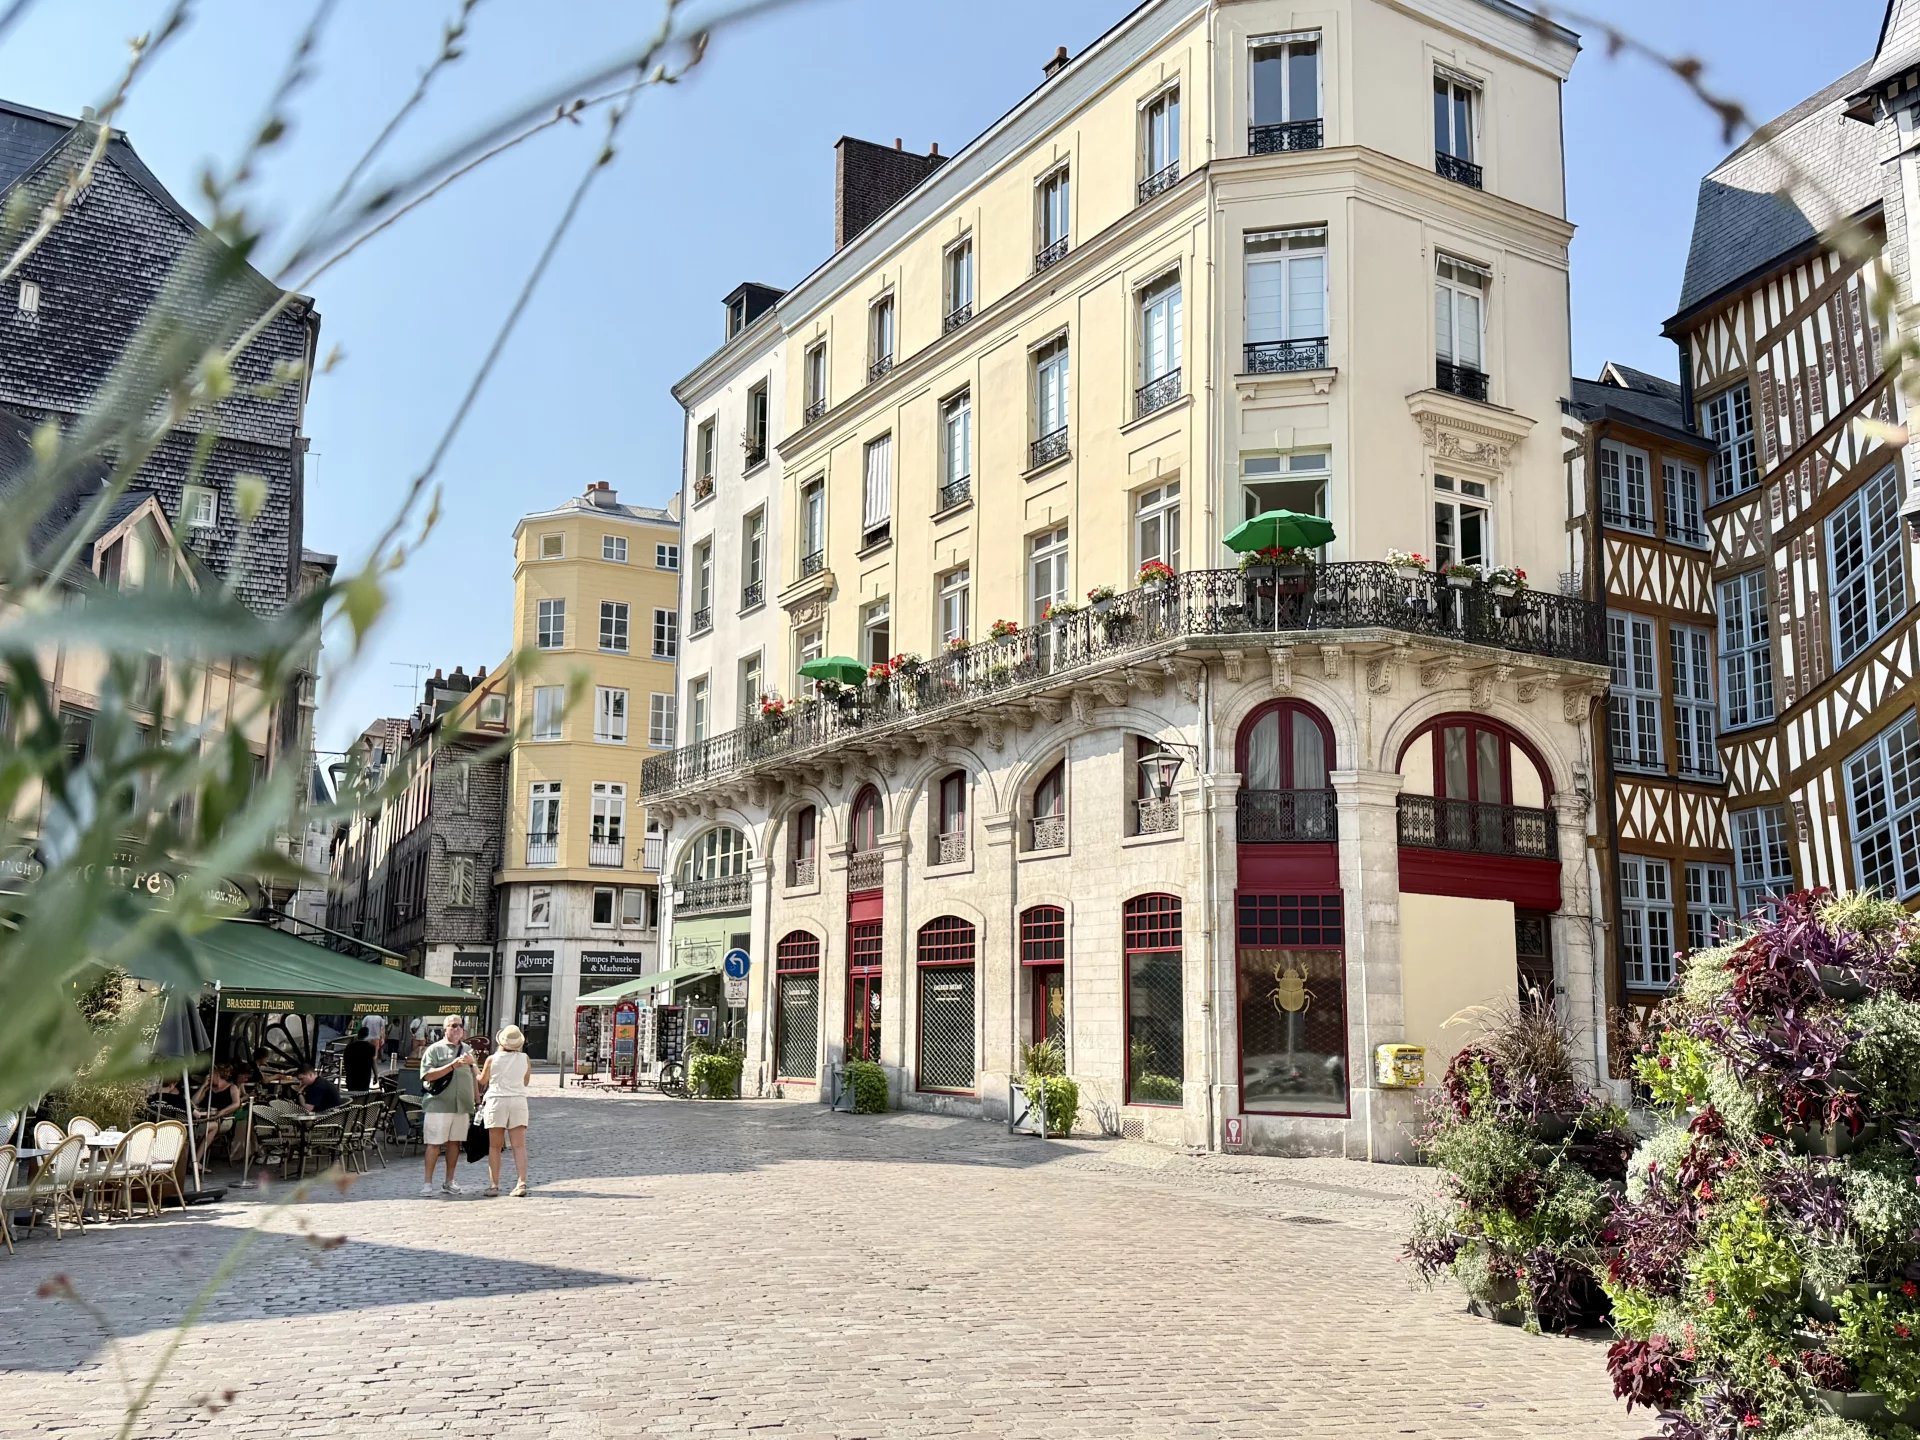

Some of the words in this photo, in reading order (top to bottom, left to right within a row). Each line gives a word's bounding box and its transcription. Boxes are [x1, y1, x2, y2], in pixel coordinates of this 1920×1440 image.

[453, 959, 489, 968] Marbrerie
[517, 954, 553, 969] Olympe
[582, 954, 609, 965] Pompes
[610, 955, 640, 964] Funèbres
[599, 964, 633, 973] Marbrerie
[226, 998, 261, 1009] BRASSERIE
[262, 999, 295, 1010] ITALIENNE
[352, 1003, 373, 1013] ANTICO
